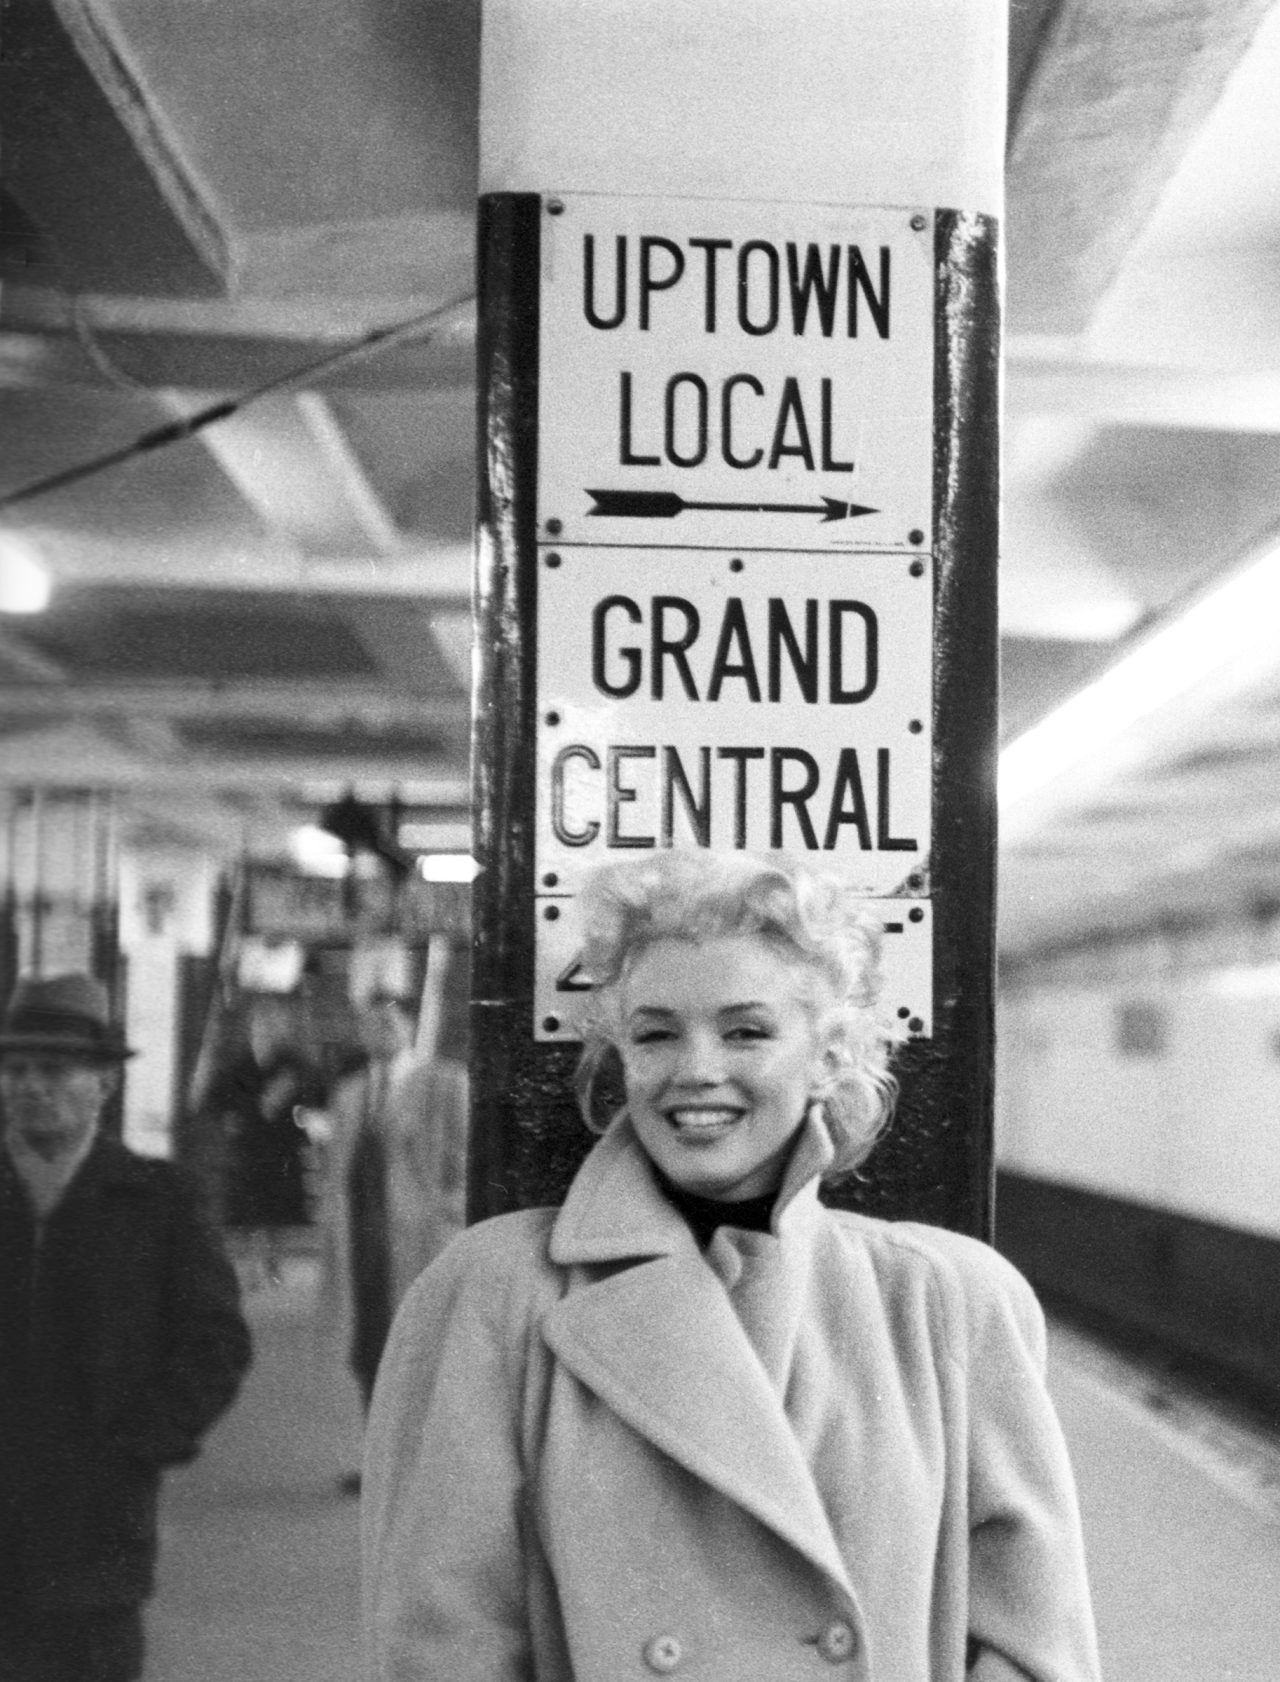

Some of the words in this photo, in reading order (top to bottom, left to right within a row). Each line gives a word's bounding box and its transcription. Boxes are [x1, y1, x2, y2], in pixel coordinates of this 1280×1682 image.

[583, 233, 891, 340] UPTOWN
[619, 370, 855, 473] LOCAL
[592, 594, 880, 705] GRAND
[551, 744, 919, 851] CENTRAL
